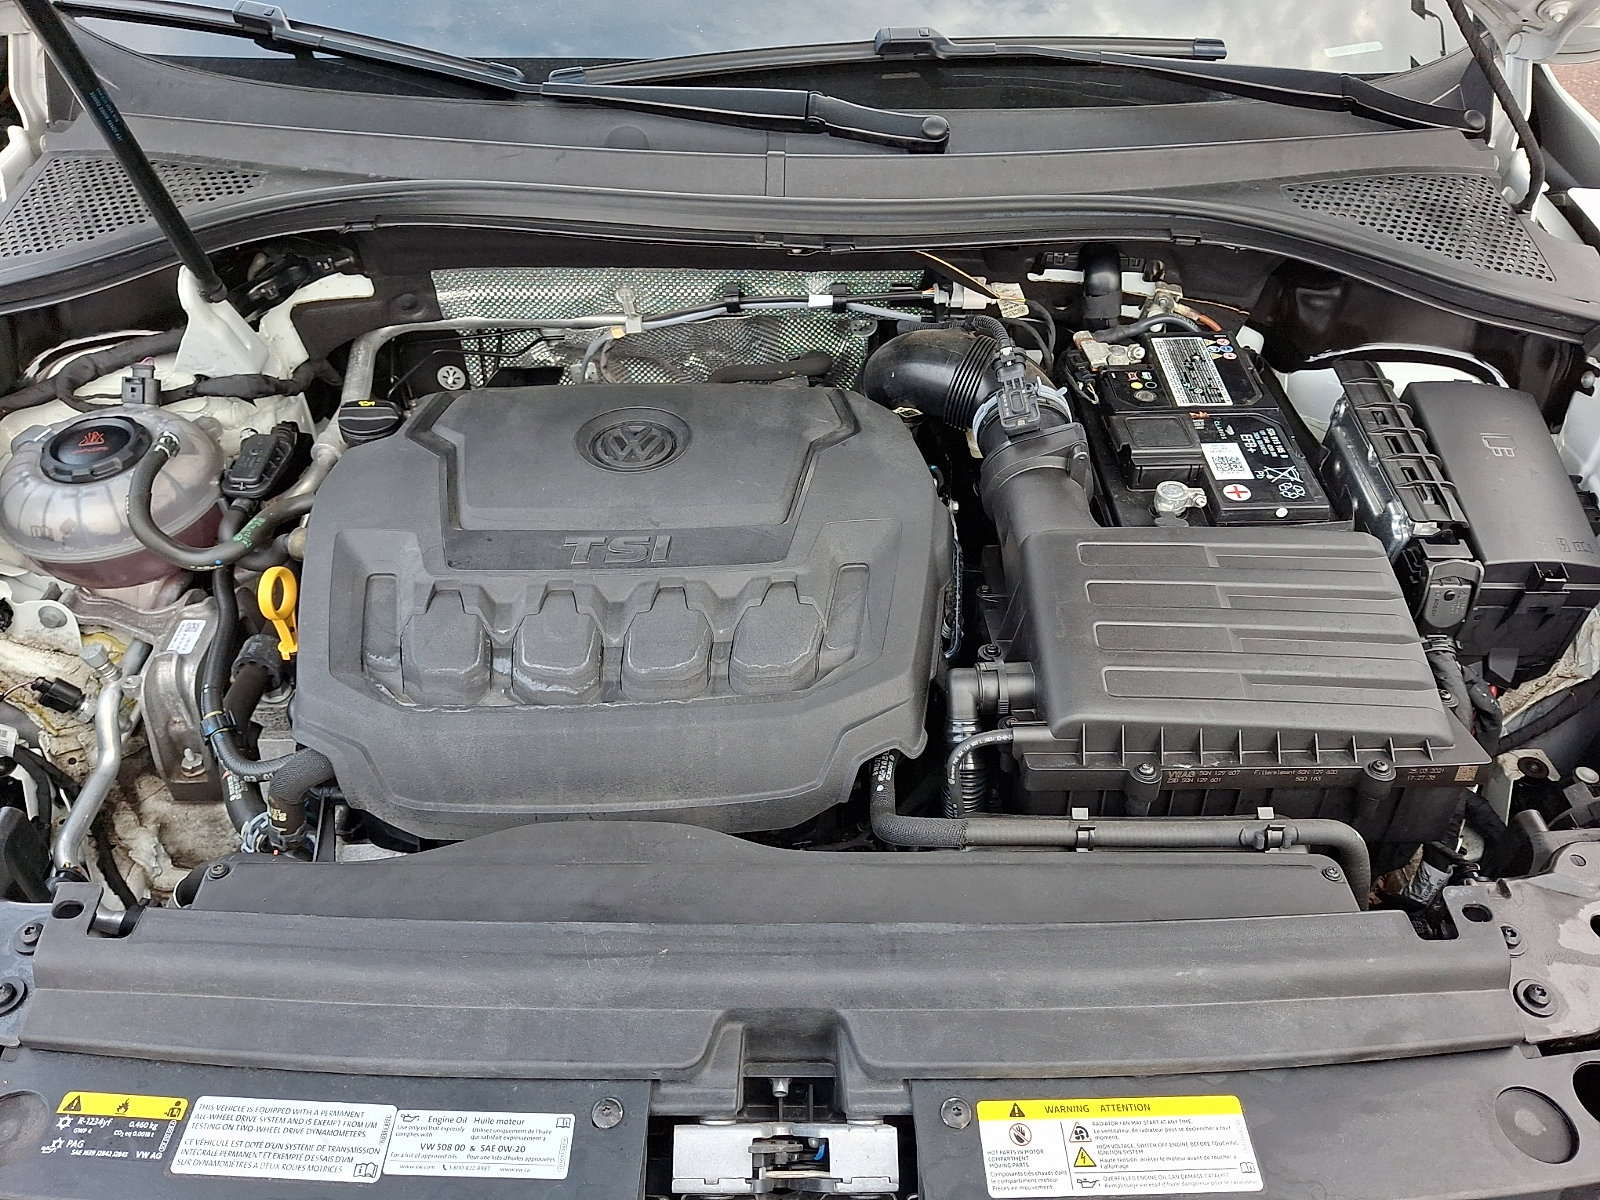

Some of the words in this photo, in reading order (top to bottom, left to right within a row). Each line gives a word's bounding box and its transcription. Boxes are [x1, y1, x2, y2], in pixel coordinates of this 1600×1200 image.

[1240, 434, 1257, 453] EFB+
[564, 536, 672, 564] TSI
[255, 1106, 291, 1115] EQUIPPED
[320, 1110, 365, 1118] PERMANENT
[1044, 1105, 1090, 1114] WARNING
[1100, 1103, 1151, 1112] ATTENTION
[77, 1117, 113, 1128] R-1234yf
[148, 1122, 158, 1130] kg
[428, 1116, 454, 1125] Engine
[236, 1124, 281, 1133] TWO-WHEEL
[66, 1140, 85, 1148] PAG
[195, 1138, 230, 1147] VÉHICULE
[244, 1140, 264, 1148] DOTÉ
[328, 1145, 380, 1155] TRANSMISSION
[219, 1150, 261, 1158] PERMANENT
